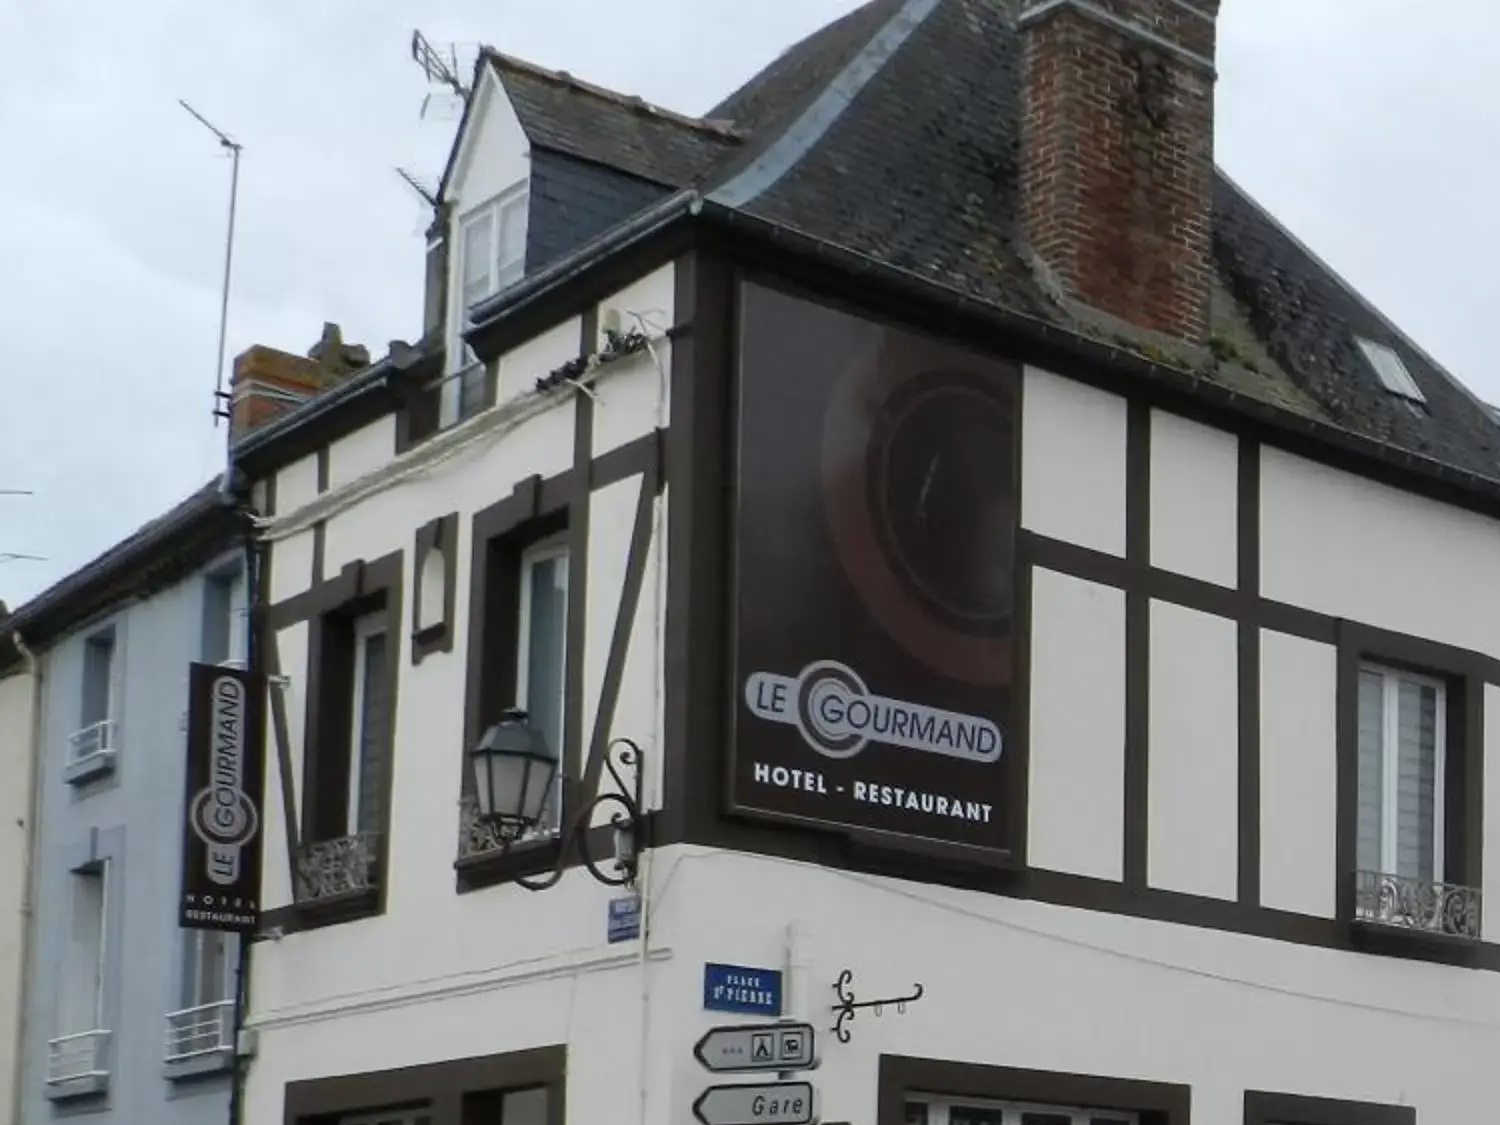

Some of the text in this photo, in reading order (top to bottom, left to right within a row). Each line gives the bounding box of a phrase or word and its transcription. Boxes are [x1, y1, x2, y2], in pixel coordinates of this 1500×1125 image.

[756, 679, 997, 755] LE GOURMAND
[213, 680, 240, 877] LE GOURMAND
[754, 762, 827, 794] HOTEL
[853, 780, 993, 823] RESTAURANT
[726, 974, 761, 988] PLACE
[752, 1095, 803, 1116] Gare
